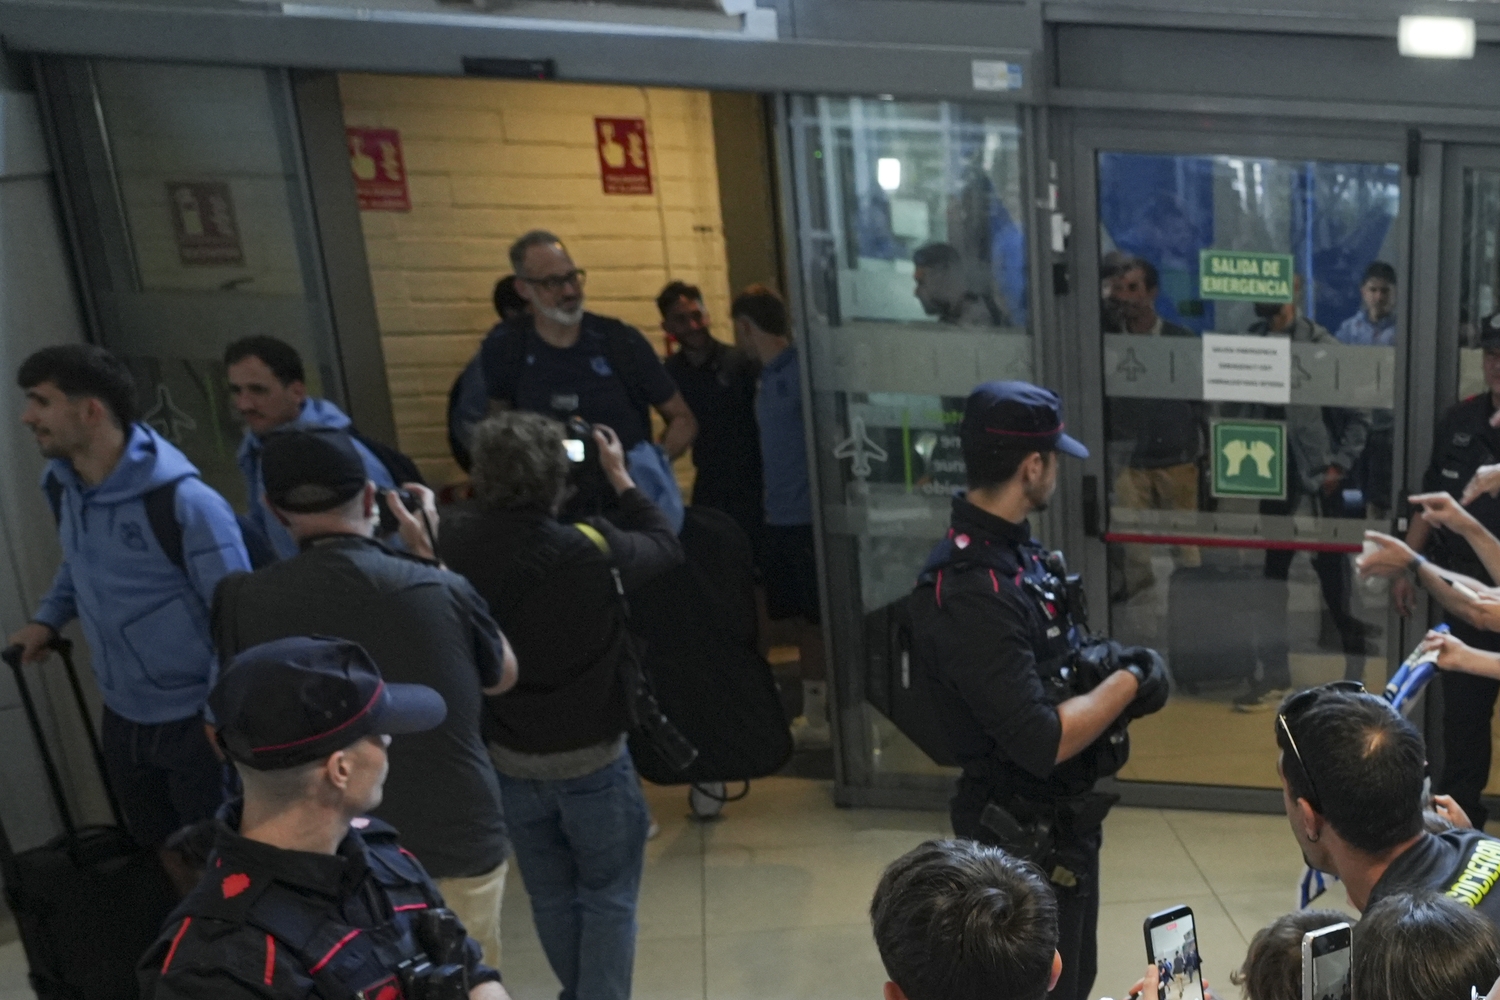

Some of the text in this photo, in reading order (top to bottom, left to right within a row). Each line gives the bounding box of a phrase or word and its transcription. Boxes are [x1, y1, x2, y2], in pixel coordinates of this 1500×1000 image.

[1211, 257, 1280, 277] SALIDA DE
[1202, 276, 1289, 296] EMERGENCIA
